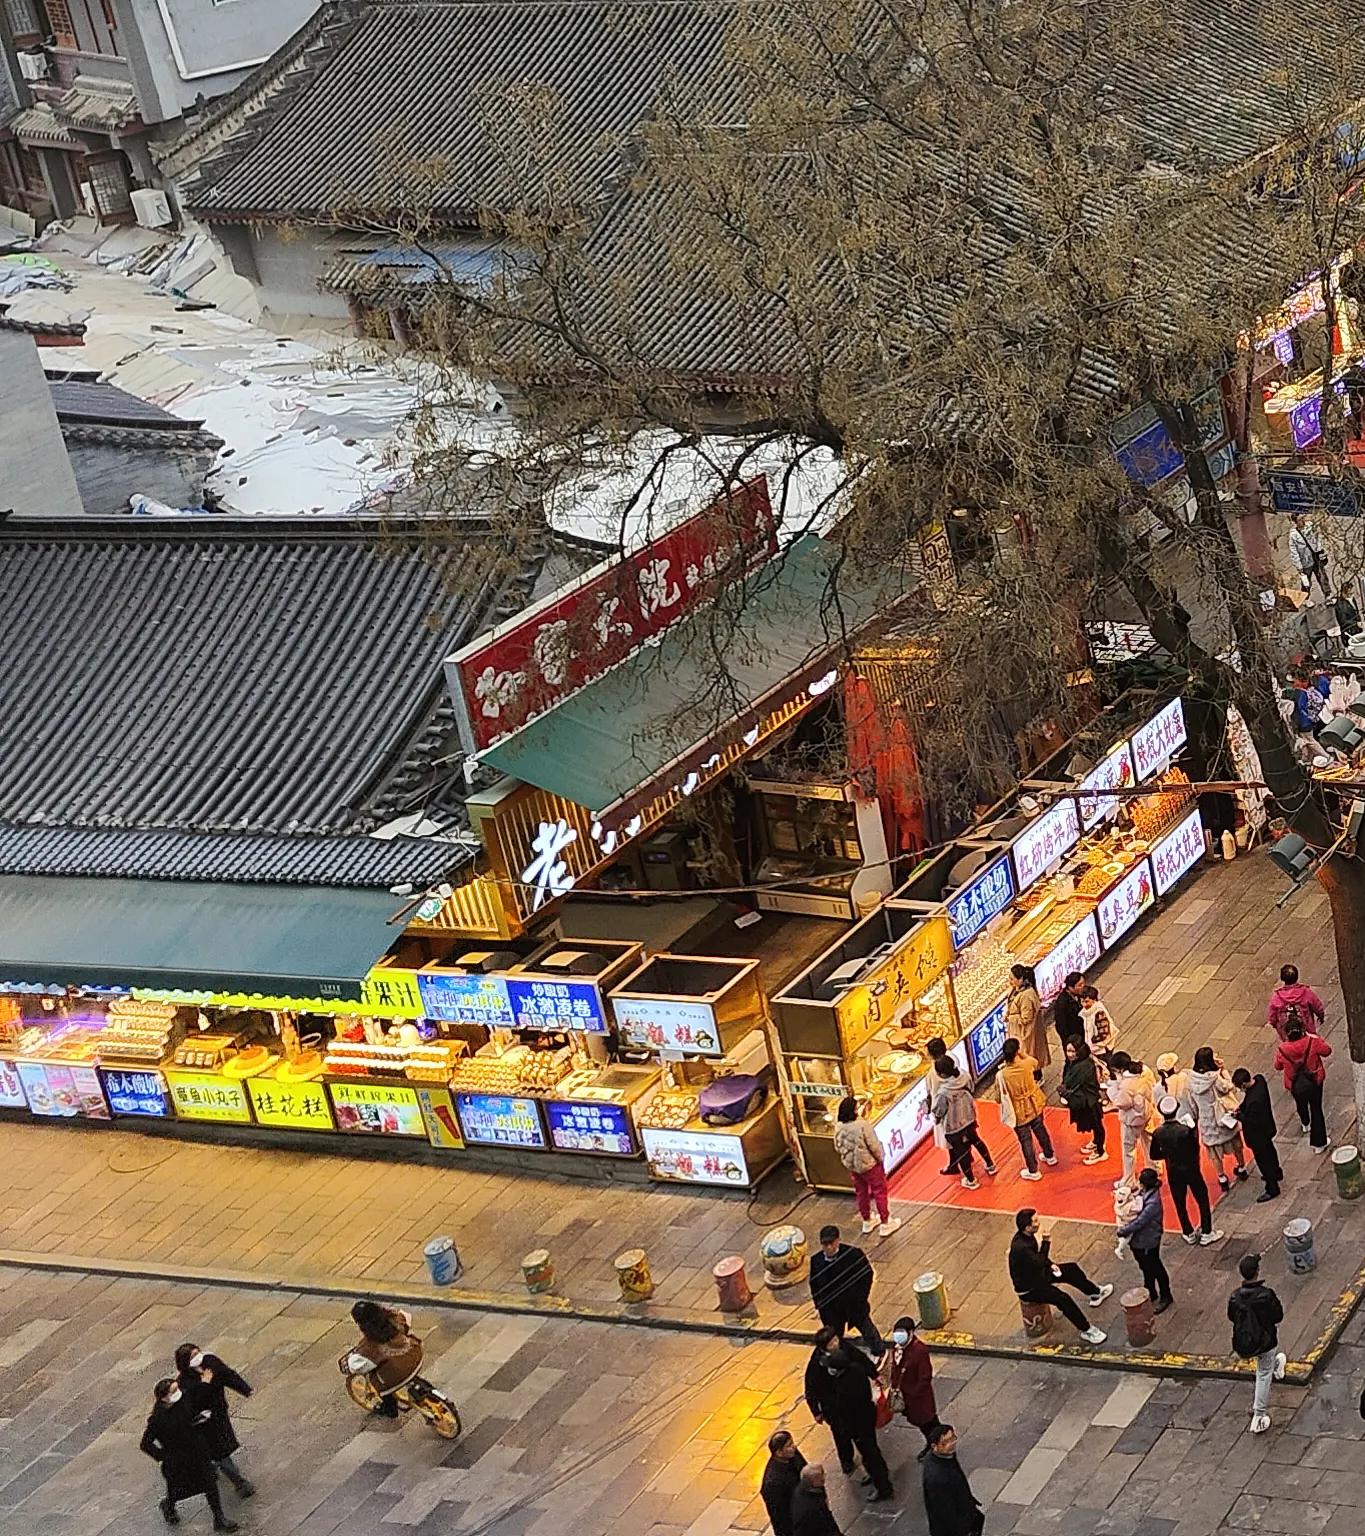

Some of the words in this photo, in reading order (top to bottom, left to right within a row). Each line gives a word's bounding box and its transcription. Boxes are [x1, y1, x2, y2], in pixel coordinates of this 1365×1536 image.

[257, 1093, 328, 1120] 桂花糕
[887, 1097, 930, 1158] 肉夹
